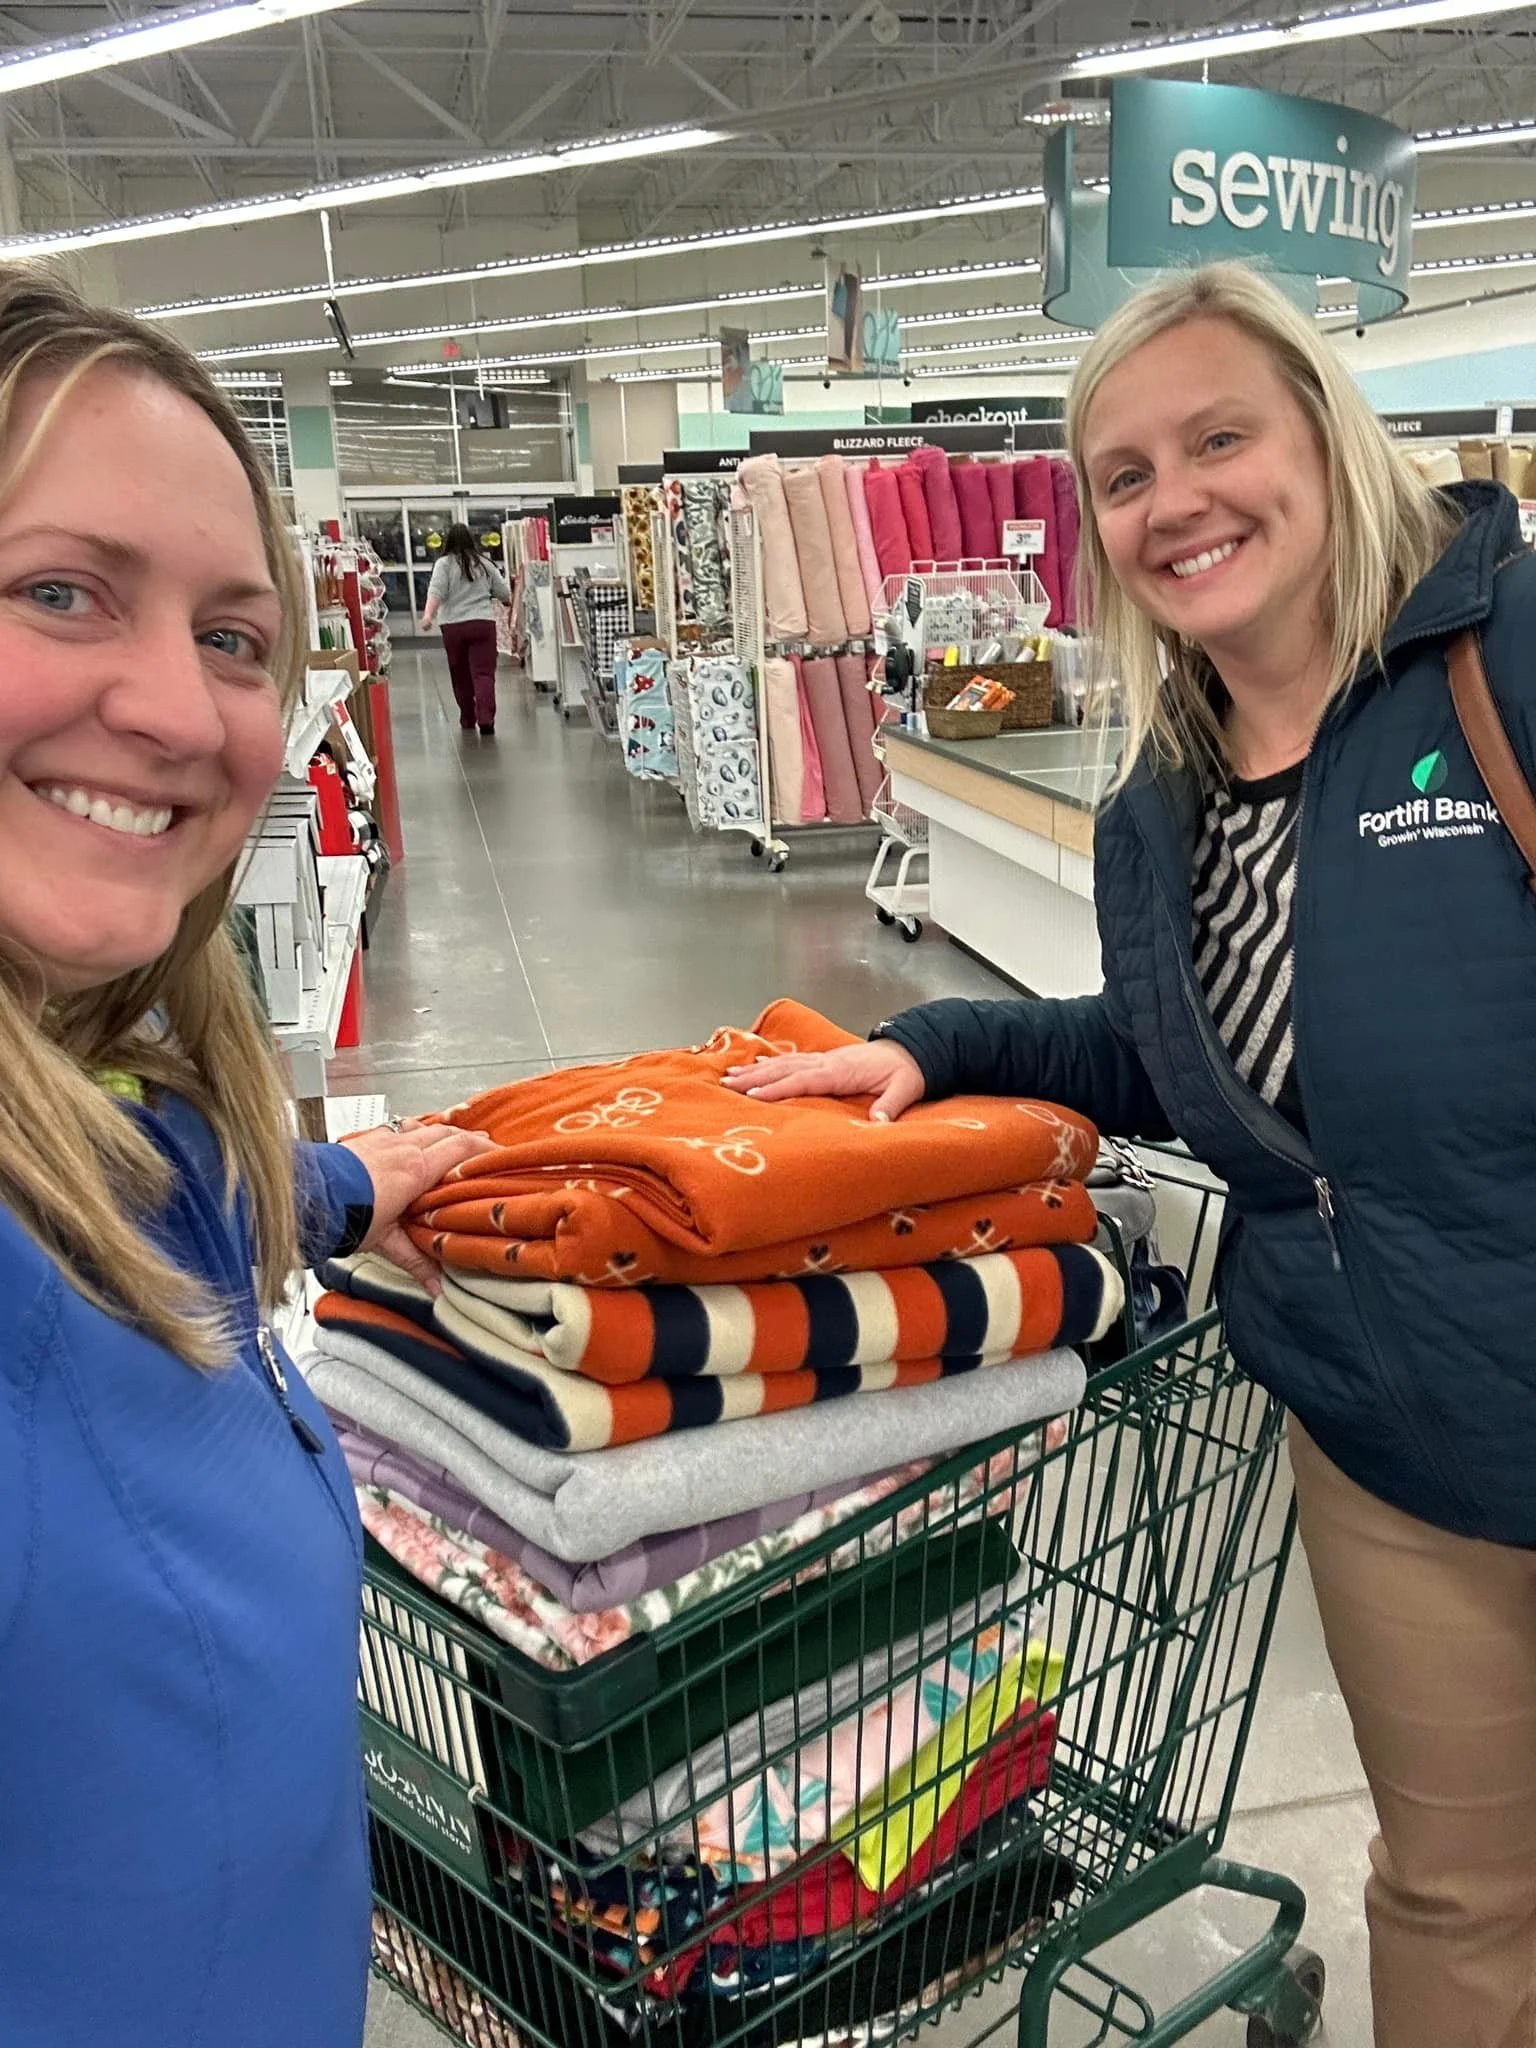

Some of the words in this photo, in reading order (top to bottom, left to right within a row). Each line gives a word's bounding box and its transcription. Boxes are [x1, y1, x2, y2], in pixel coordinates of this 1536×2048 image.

[1171, 135, 1403, 276] sewing
[1387, 420, 1422, 432] FLEECE
[833, 438, 884, 449] BLIZZARD
[887, 437, 925, 448] FLEECE
[1359, 799, 1429, 836] Fortifi
[1435, 797, 1500, 824] Bank
[1422, 823, 1484, 840] Wisconsin
[397, 1791, 415, 1809] and
